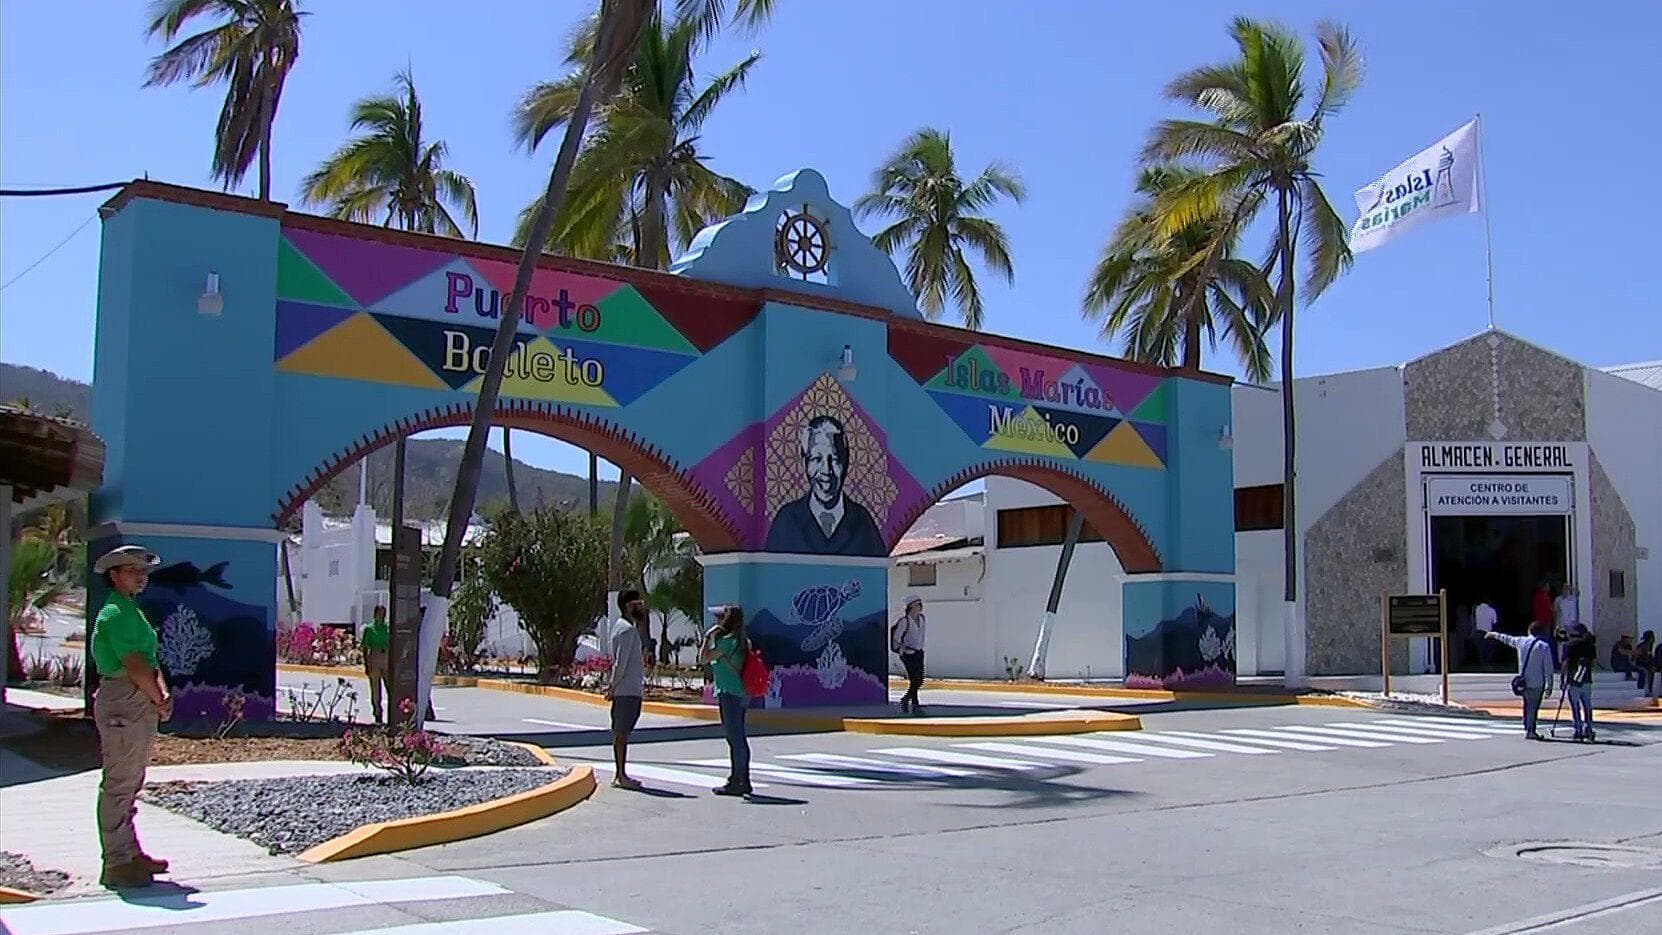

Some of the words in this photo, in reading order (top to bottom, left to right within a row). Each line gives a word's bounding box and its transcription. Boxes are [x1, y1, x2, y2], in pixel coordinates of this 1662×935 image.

[945, 354, 1011, 395] Islas
[1019, 366, 1115, 411] Marías
[988, 404, 1079, 445] México
[1504, 446, 1573, 467] GENERAL
[1470, 483, 1513, 493] CENTRO
[1515, 484, 1529, 493] DE
[1491, 496, 1500, 505] A
[1502, 495, 1559, 505] VISITANTES
